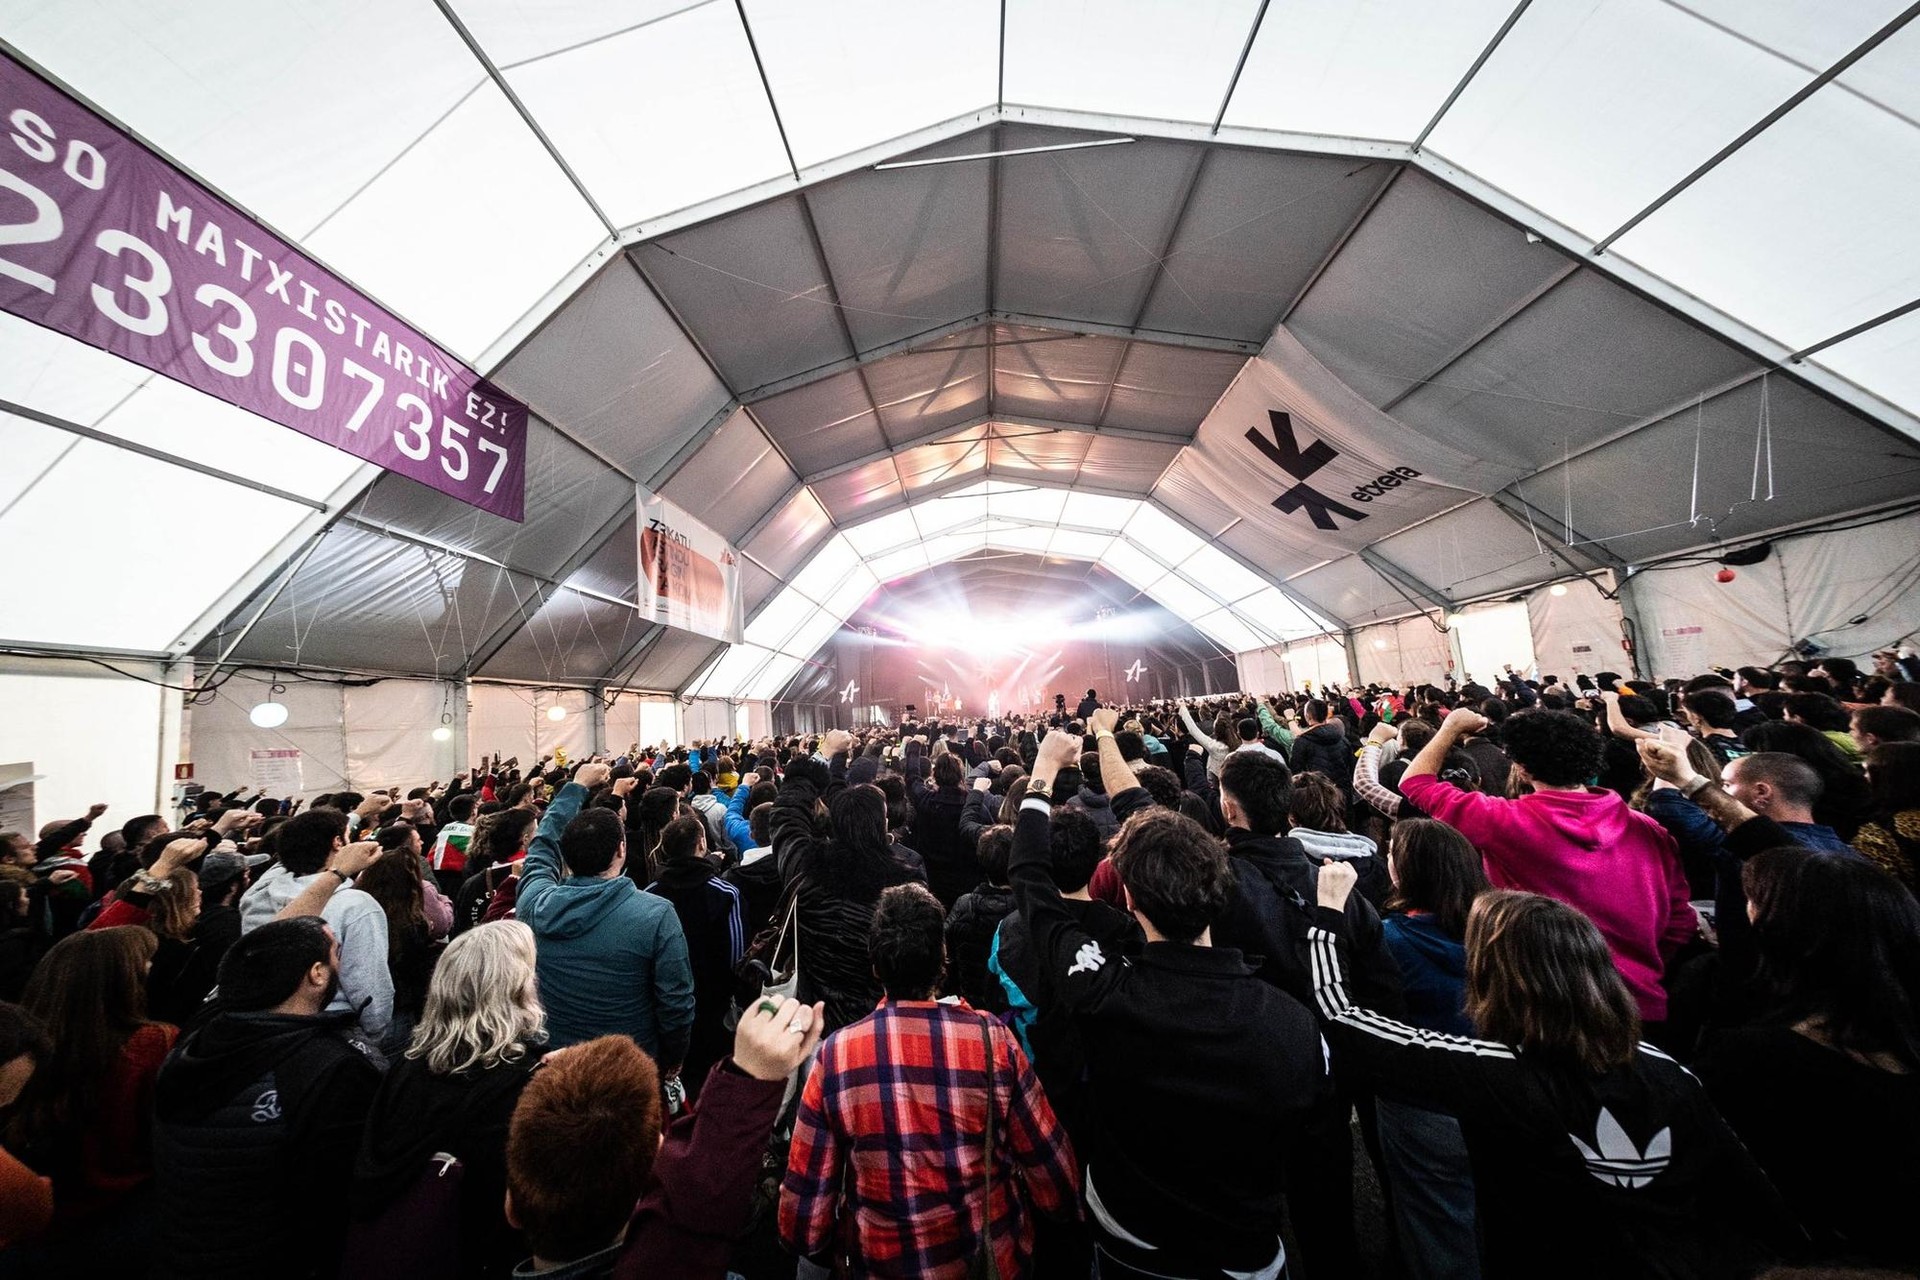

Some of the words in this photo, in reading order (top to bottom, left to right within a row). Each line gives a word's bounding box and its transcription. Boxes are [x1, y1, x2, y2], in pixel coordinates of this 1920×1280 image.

[157, 191, 450, 400] MATXISTARIK
[465, 391, 507, 435] EZ!
[1351, 466, 1423, 502] etxera
